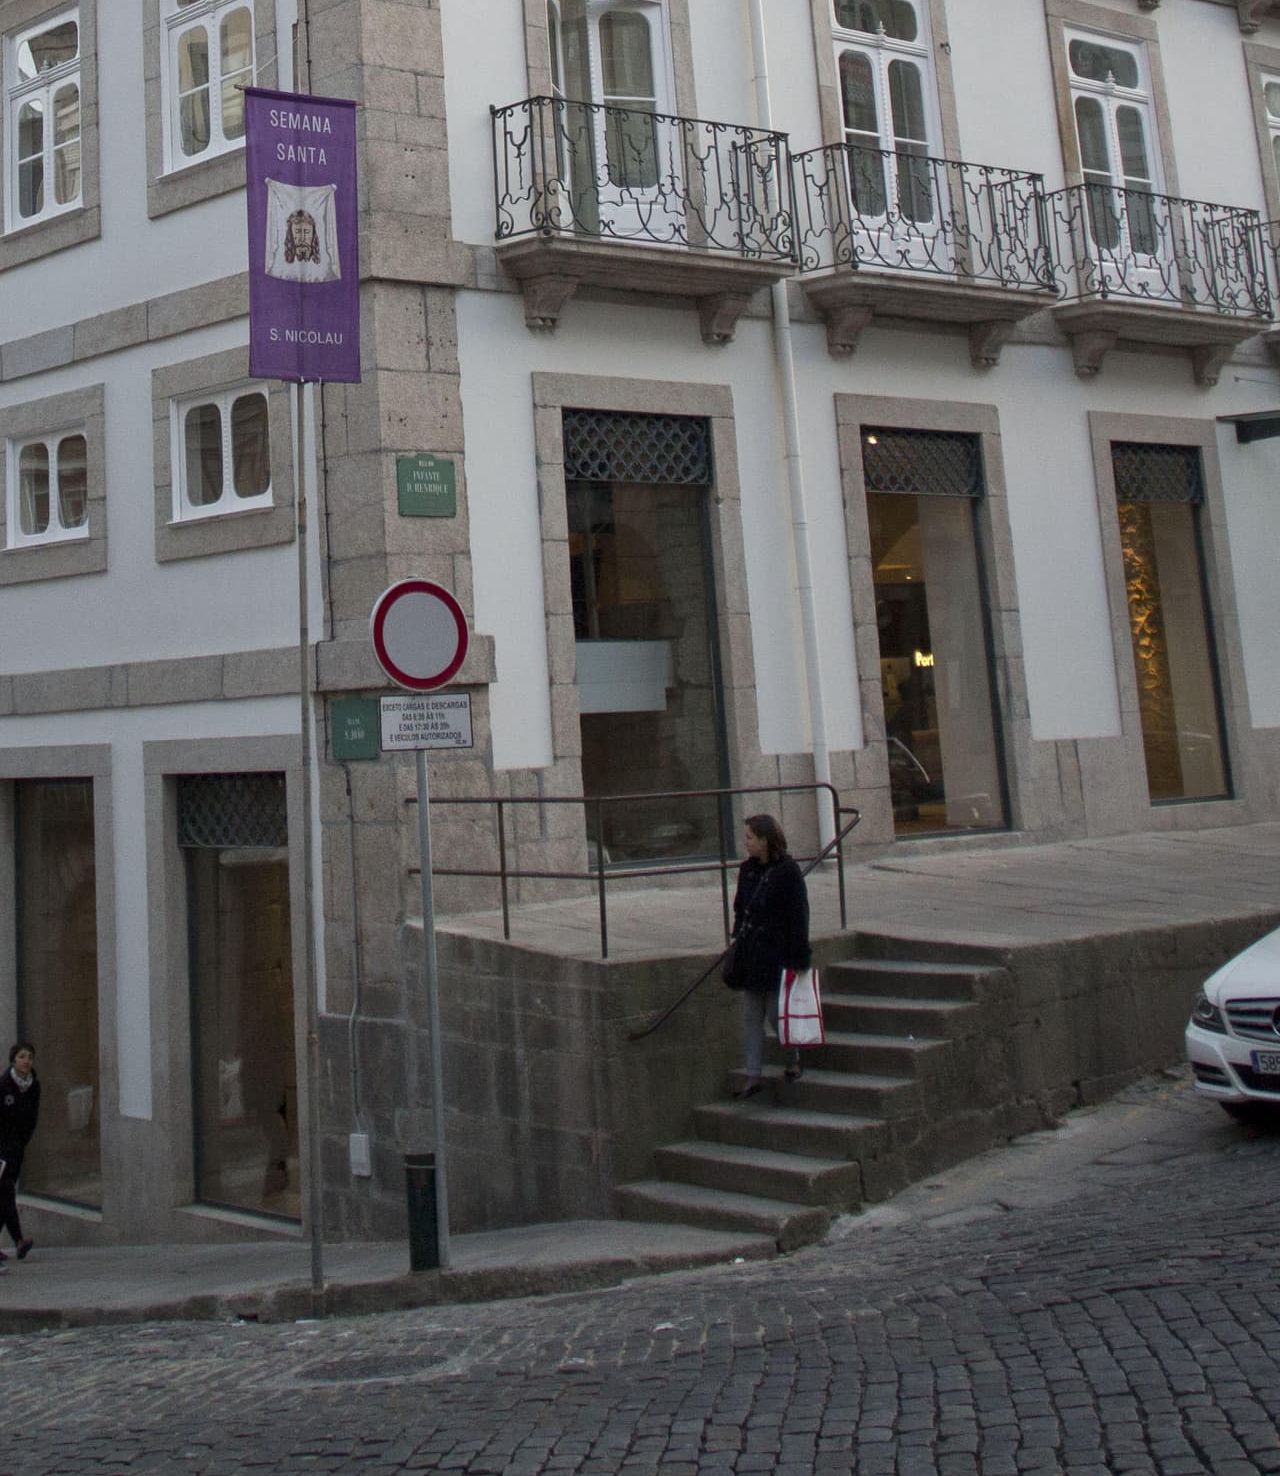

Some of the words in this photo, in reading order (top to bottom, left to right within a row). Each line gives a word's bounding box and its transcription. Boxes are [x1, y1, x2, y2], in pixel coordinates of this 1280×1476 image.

[270, 109, 332, 135] SEMANA
[276, 142, 328, 166] SANTA
[269, 327, 282, 342] S.
[285, 329, 344, 346] NICOLAU
[413, 470, 441, 482] INFANTE
[414, 483, 449, 495] HENRIQUE
[403, 702, 424, 711] CARGAS
[431, 701, 468, 710] DESCARGAS
[421, 731, 462, 741] AUTORIZADOS
